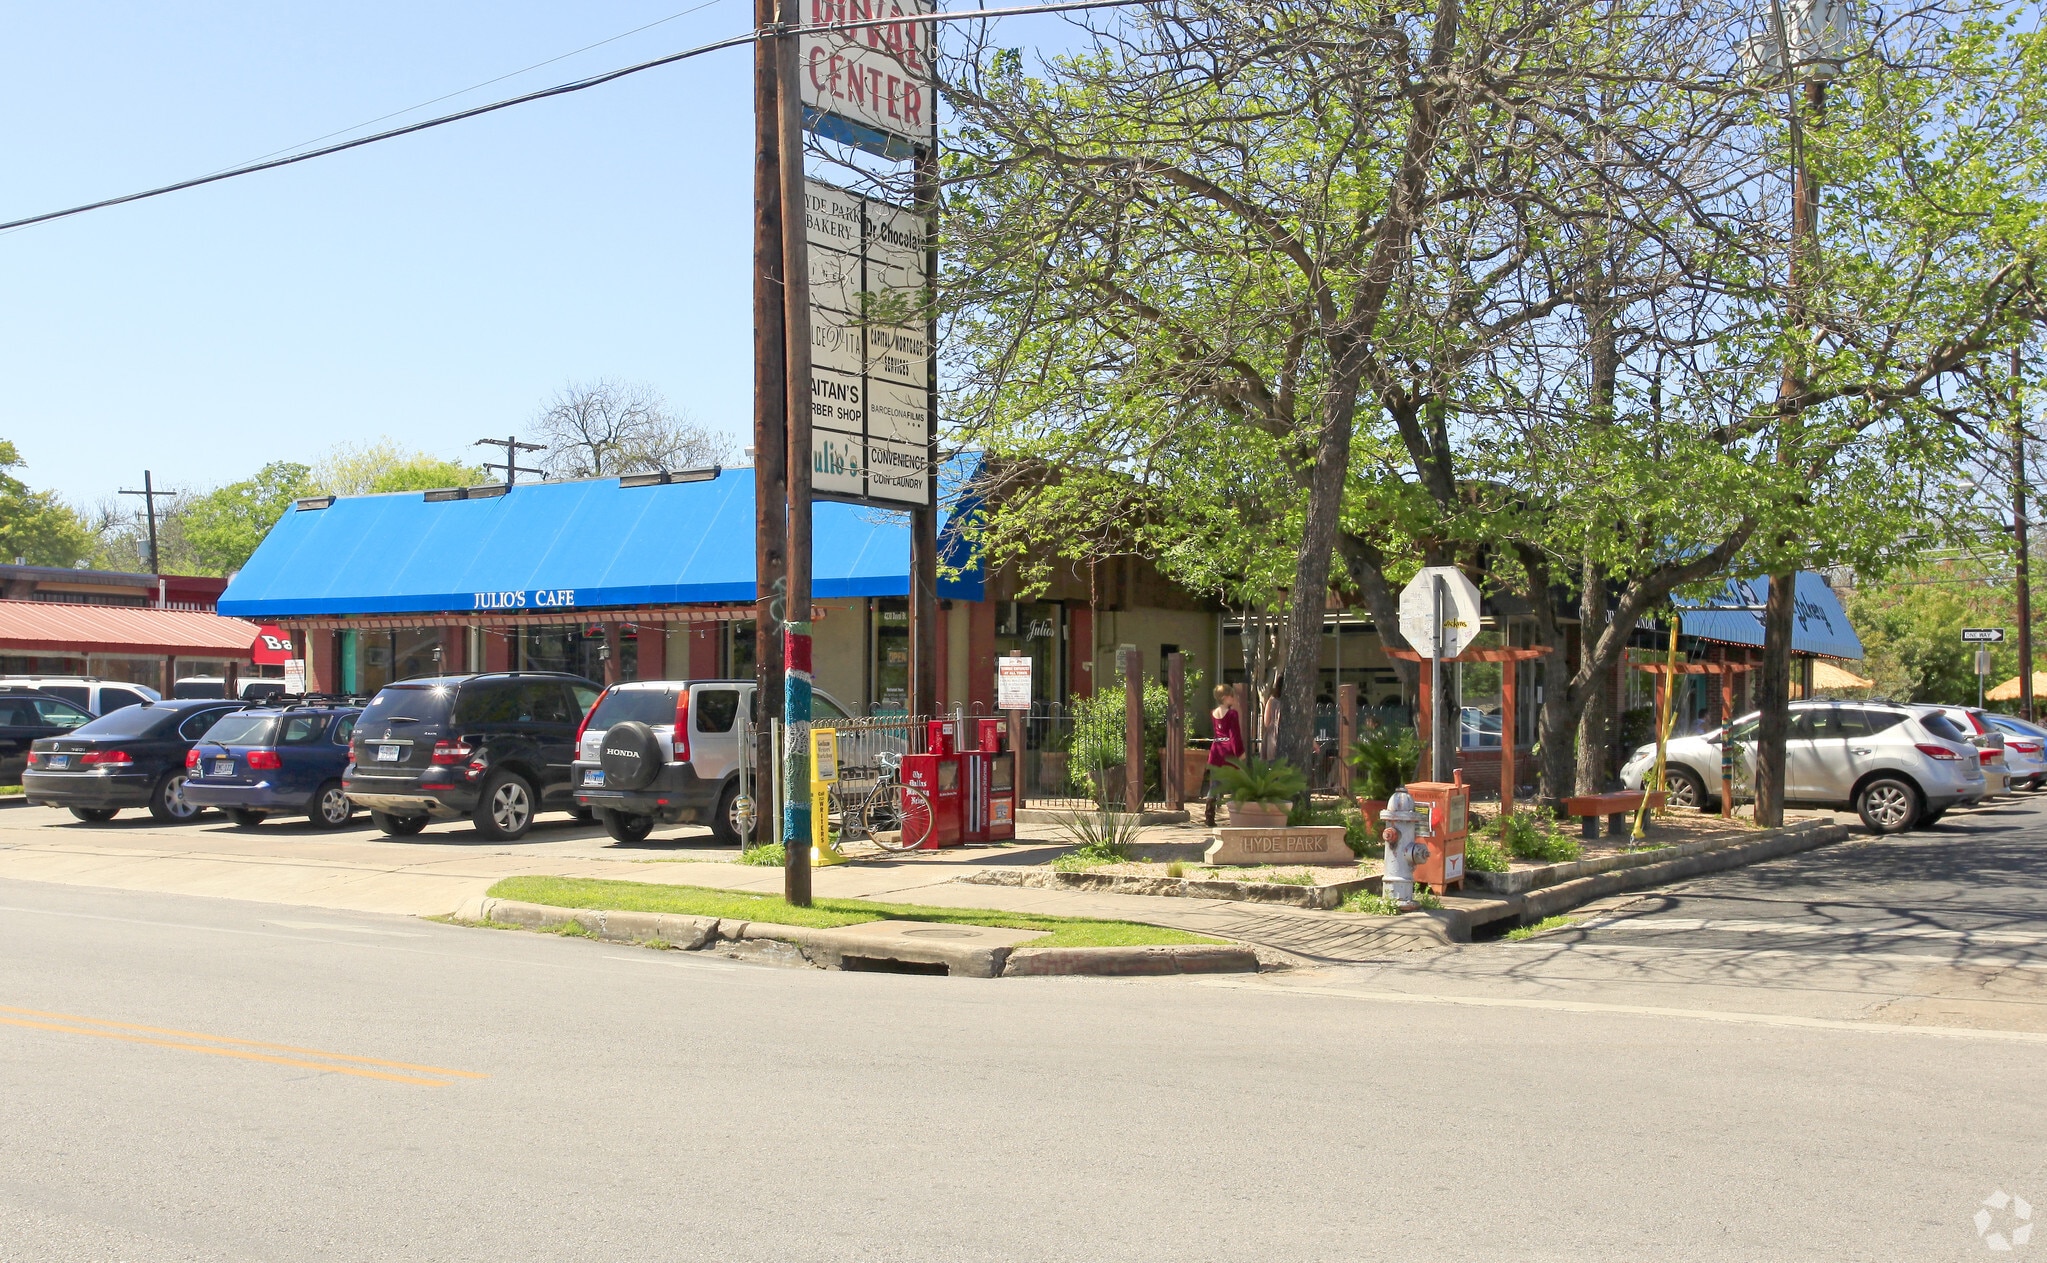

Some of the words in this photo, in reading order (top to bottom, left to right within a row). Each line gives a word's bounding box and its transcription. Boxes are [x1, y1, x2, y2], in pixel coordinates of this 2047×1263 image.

[809, 45, 922, 127] CENTER
[805, 193, 827, 211] YDE
[832, 201, 861, 224] PARK
[806, 213, 852, 240] BAKERY
[870, 328, 891, 348] CAPITAL
[895, 334, 923, 357] MORTGAGE
[884, 355, 909, 377] SERVICES
[812, 377, 859, 404] AITAN'S
[812, 402, 833, 418] RBER
[837, 406, 862, 422] SHOP
[813, 440, 858, 478] ulio's
[871, 448, 925, 470] CONVENIENCE
[873, 474, 890, 485] COIN
[892, 477, 923, 490] LAUNDRY
[474, 590, 526, 609] JULIO'S
[535, 589, 575, 607] CAFE
[261, 635, 293, 650] Ba
[606, 748, 641, 758] HONDA
[909, 779, 927, 787] Dallas
[912, 771, 923, 779] The
[1244, 836, 1281, 852] HYDE
[1286, 836, 1323, 851] PARK
